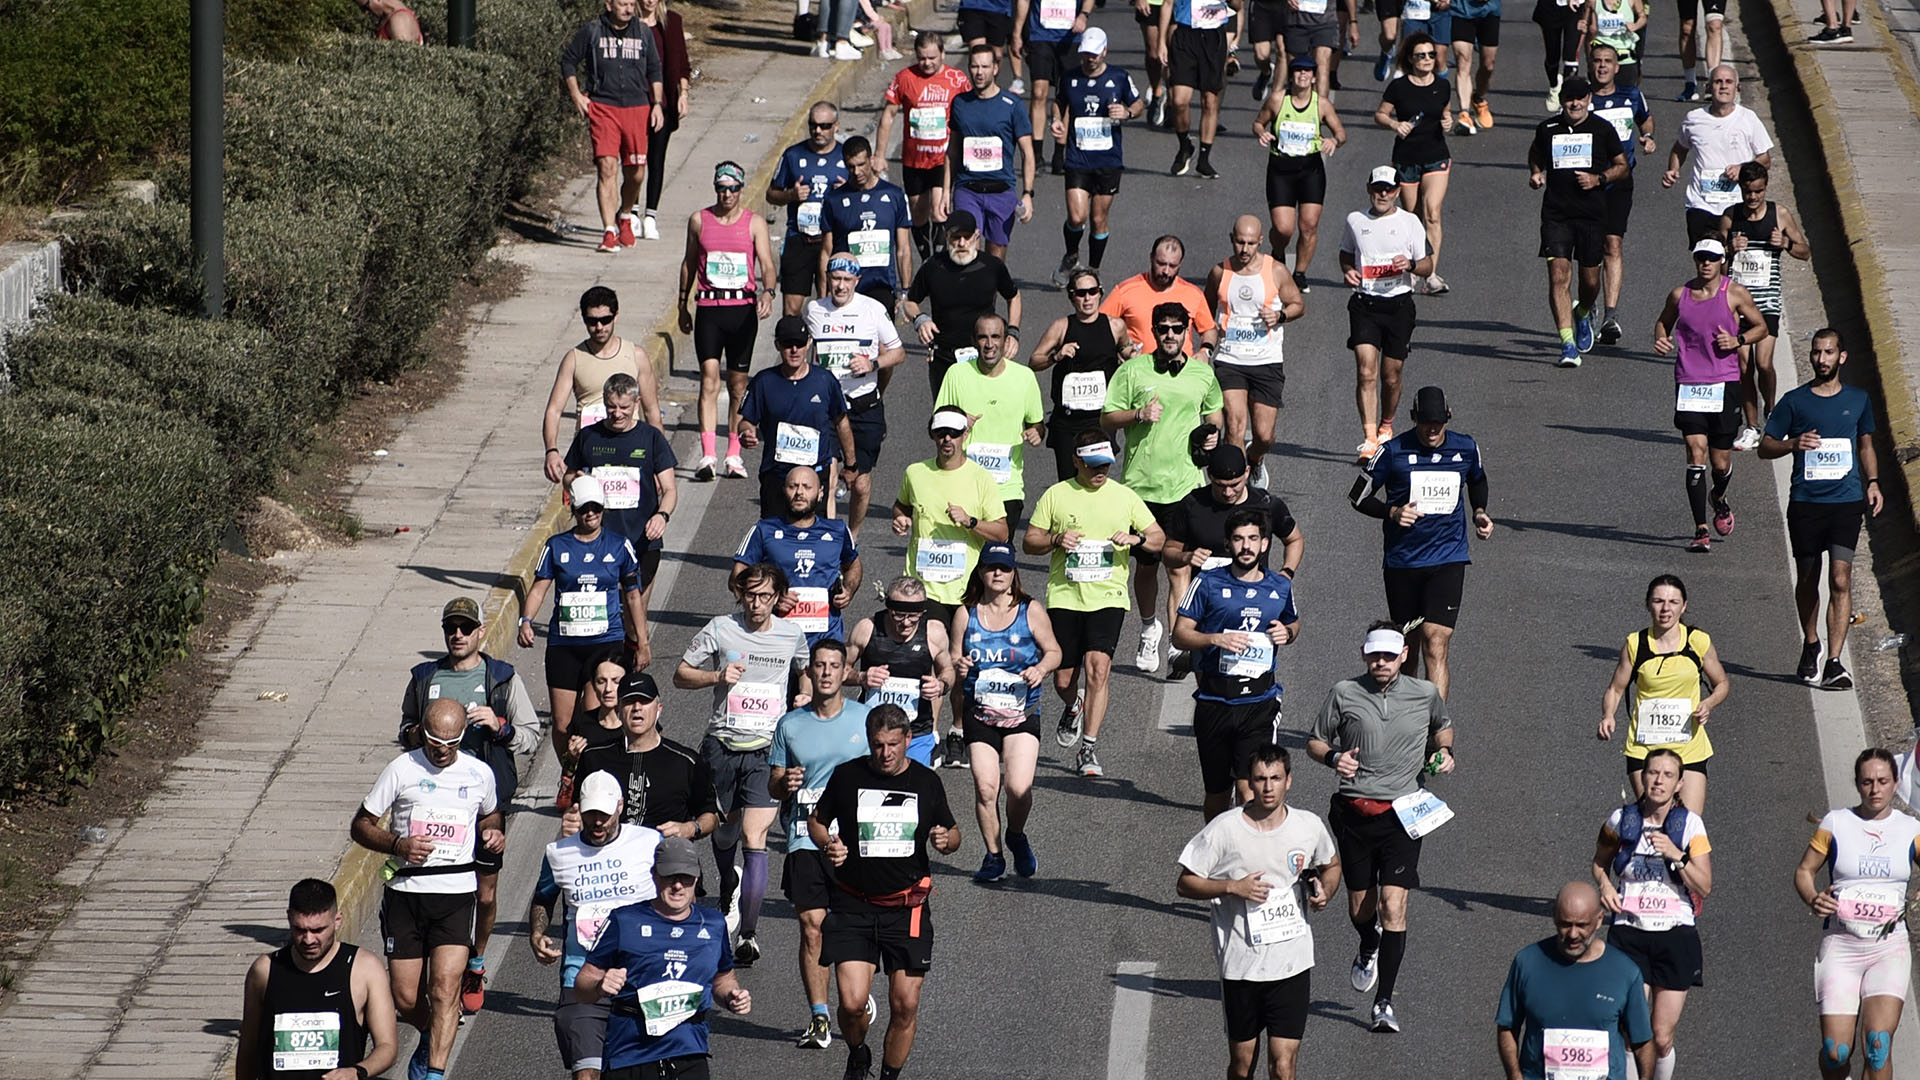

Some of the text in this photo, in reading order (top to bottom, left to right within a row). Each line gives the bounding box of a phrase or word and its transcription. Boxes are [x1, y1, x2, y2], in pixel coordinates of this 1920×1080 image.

[1562, 144, 1582, 155] 9167
[858, 242, 880, 252] 7651
[717, 262, 738, 274] 3032
[1371, 265, 1393, 276] 2284
[1235, 329, 1258, 341] 9089
[827, 353, 850, 366] 7126
[1071, 384, 1099, 396] 11730
[1690, 386, 1713, 398] 9474
[784, 437, 812, 450] 10256
[977, 456, 1001, 468] 9872
[1816, 452, 1842, 463] 9561
[602, 480, 628, 492] 6584
[1420, 486, 1451, 497] 11544
[928, 553, 954, 565] 9601
[1077, 553, 1101, 565] 7881
[569, 606, 596, 619] 8108
[741, 697, 769, 711] 6256
[878, 691, 910, 704] 10147
[1649, 713, 1682, 726] 11852
[425, 824, 455, 838] 5290
[872, 822, 903, 837] 7635
[577, 858, 622, 873] run to
[1858, 867, 1891, 878] RUN
[574, 871, 628, 888] change
[571, 884, 635, 902] diabetes
[1260, 903, 1296, 922] 15482
[1853, 903, 1885, 918] 5525
[290, 1031, 324, 1048] 8795
[1560, 1047, 1593, 1063] 5985
